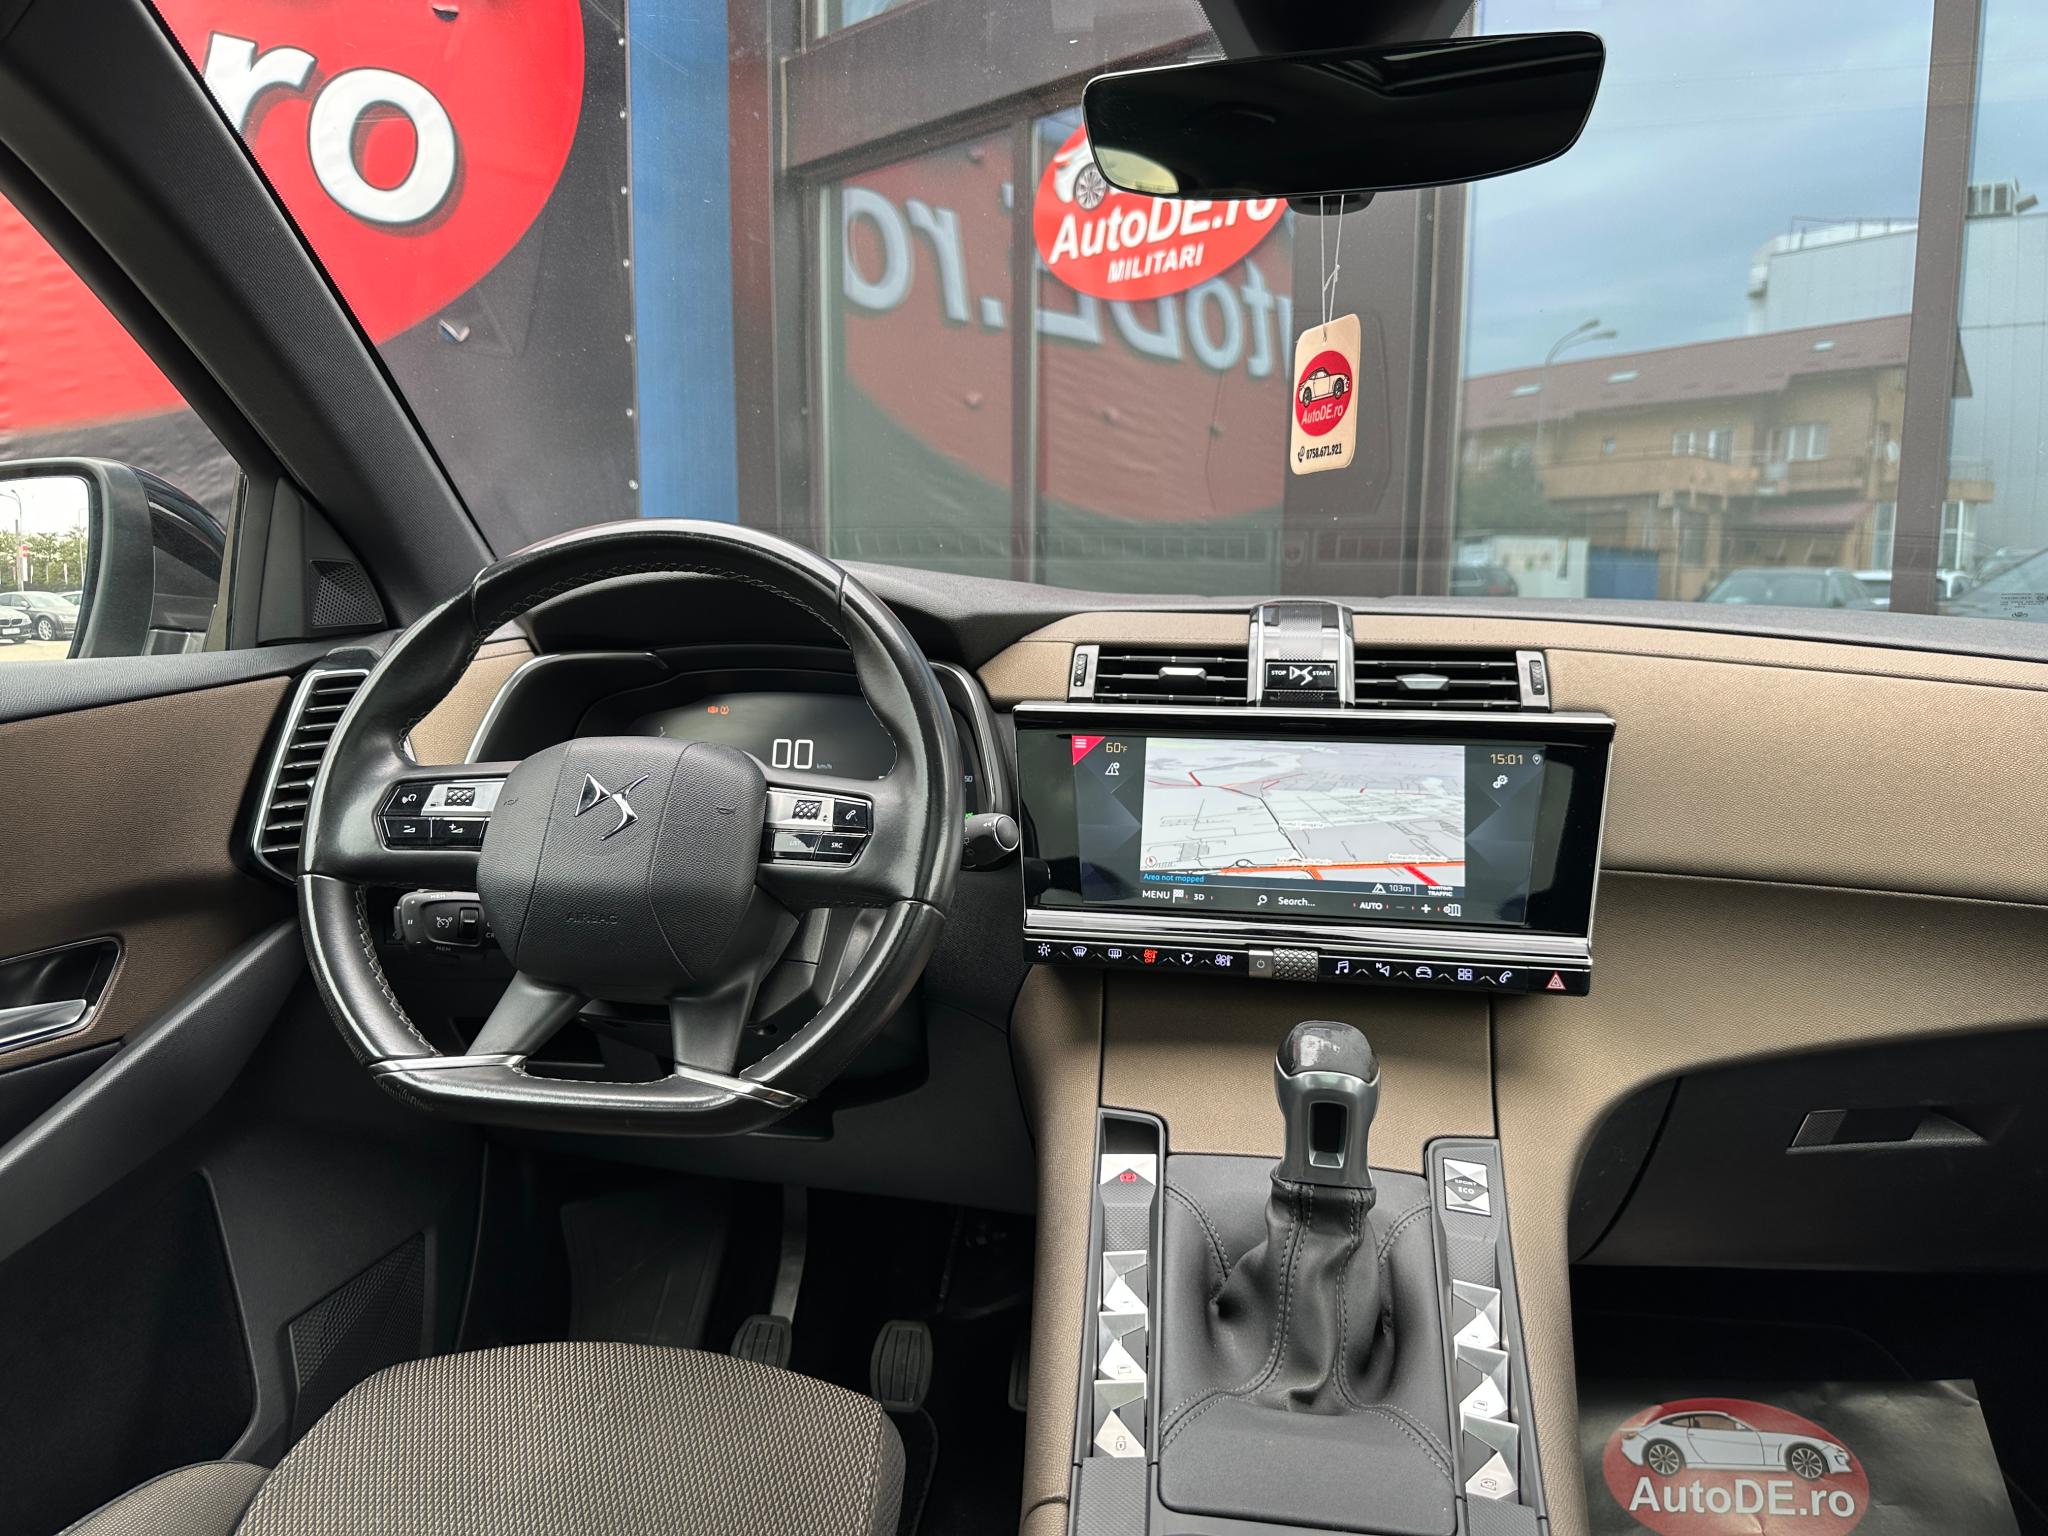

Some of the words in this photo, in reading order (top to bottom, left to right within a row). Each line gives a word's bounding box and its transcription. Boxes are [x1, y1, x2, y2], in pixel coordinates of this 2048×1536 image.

[1048, 197, 1277, 264] AutoDE.ro
[1106, 243, 1205, 284] MILITARI
[1301, 403, 1344, 425] AutoDE.ro
[1306, 443, 1342, 460] 0758.671.921
[771, 738, 814, 770] 00
[1490, 753, 1524, 765] 15:01
[1143, 873, 1161, 881] Area
[1161, 874, 1175, 882] not
[1175, 875, 1205, 884] mapped
[1142, 889, 1170, 899] MENU
[1389, 884, 1412, 893] 103m
[1193, 893, 1205, 901] 3D
[1278, 896, 1316, 907] Search...
[1359, 901, 1383, 910] AUTO
[1458, 1186, 1475, 1195] ECO
[1628, 1477, 1856, 1518] AutoDE.ro
